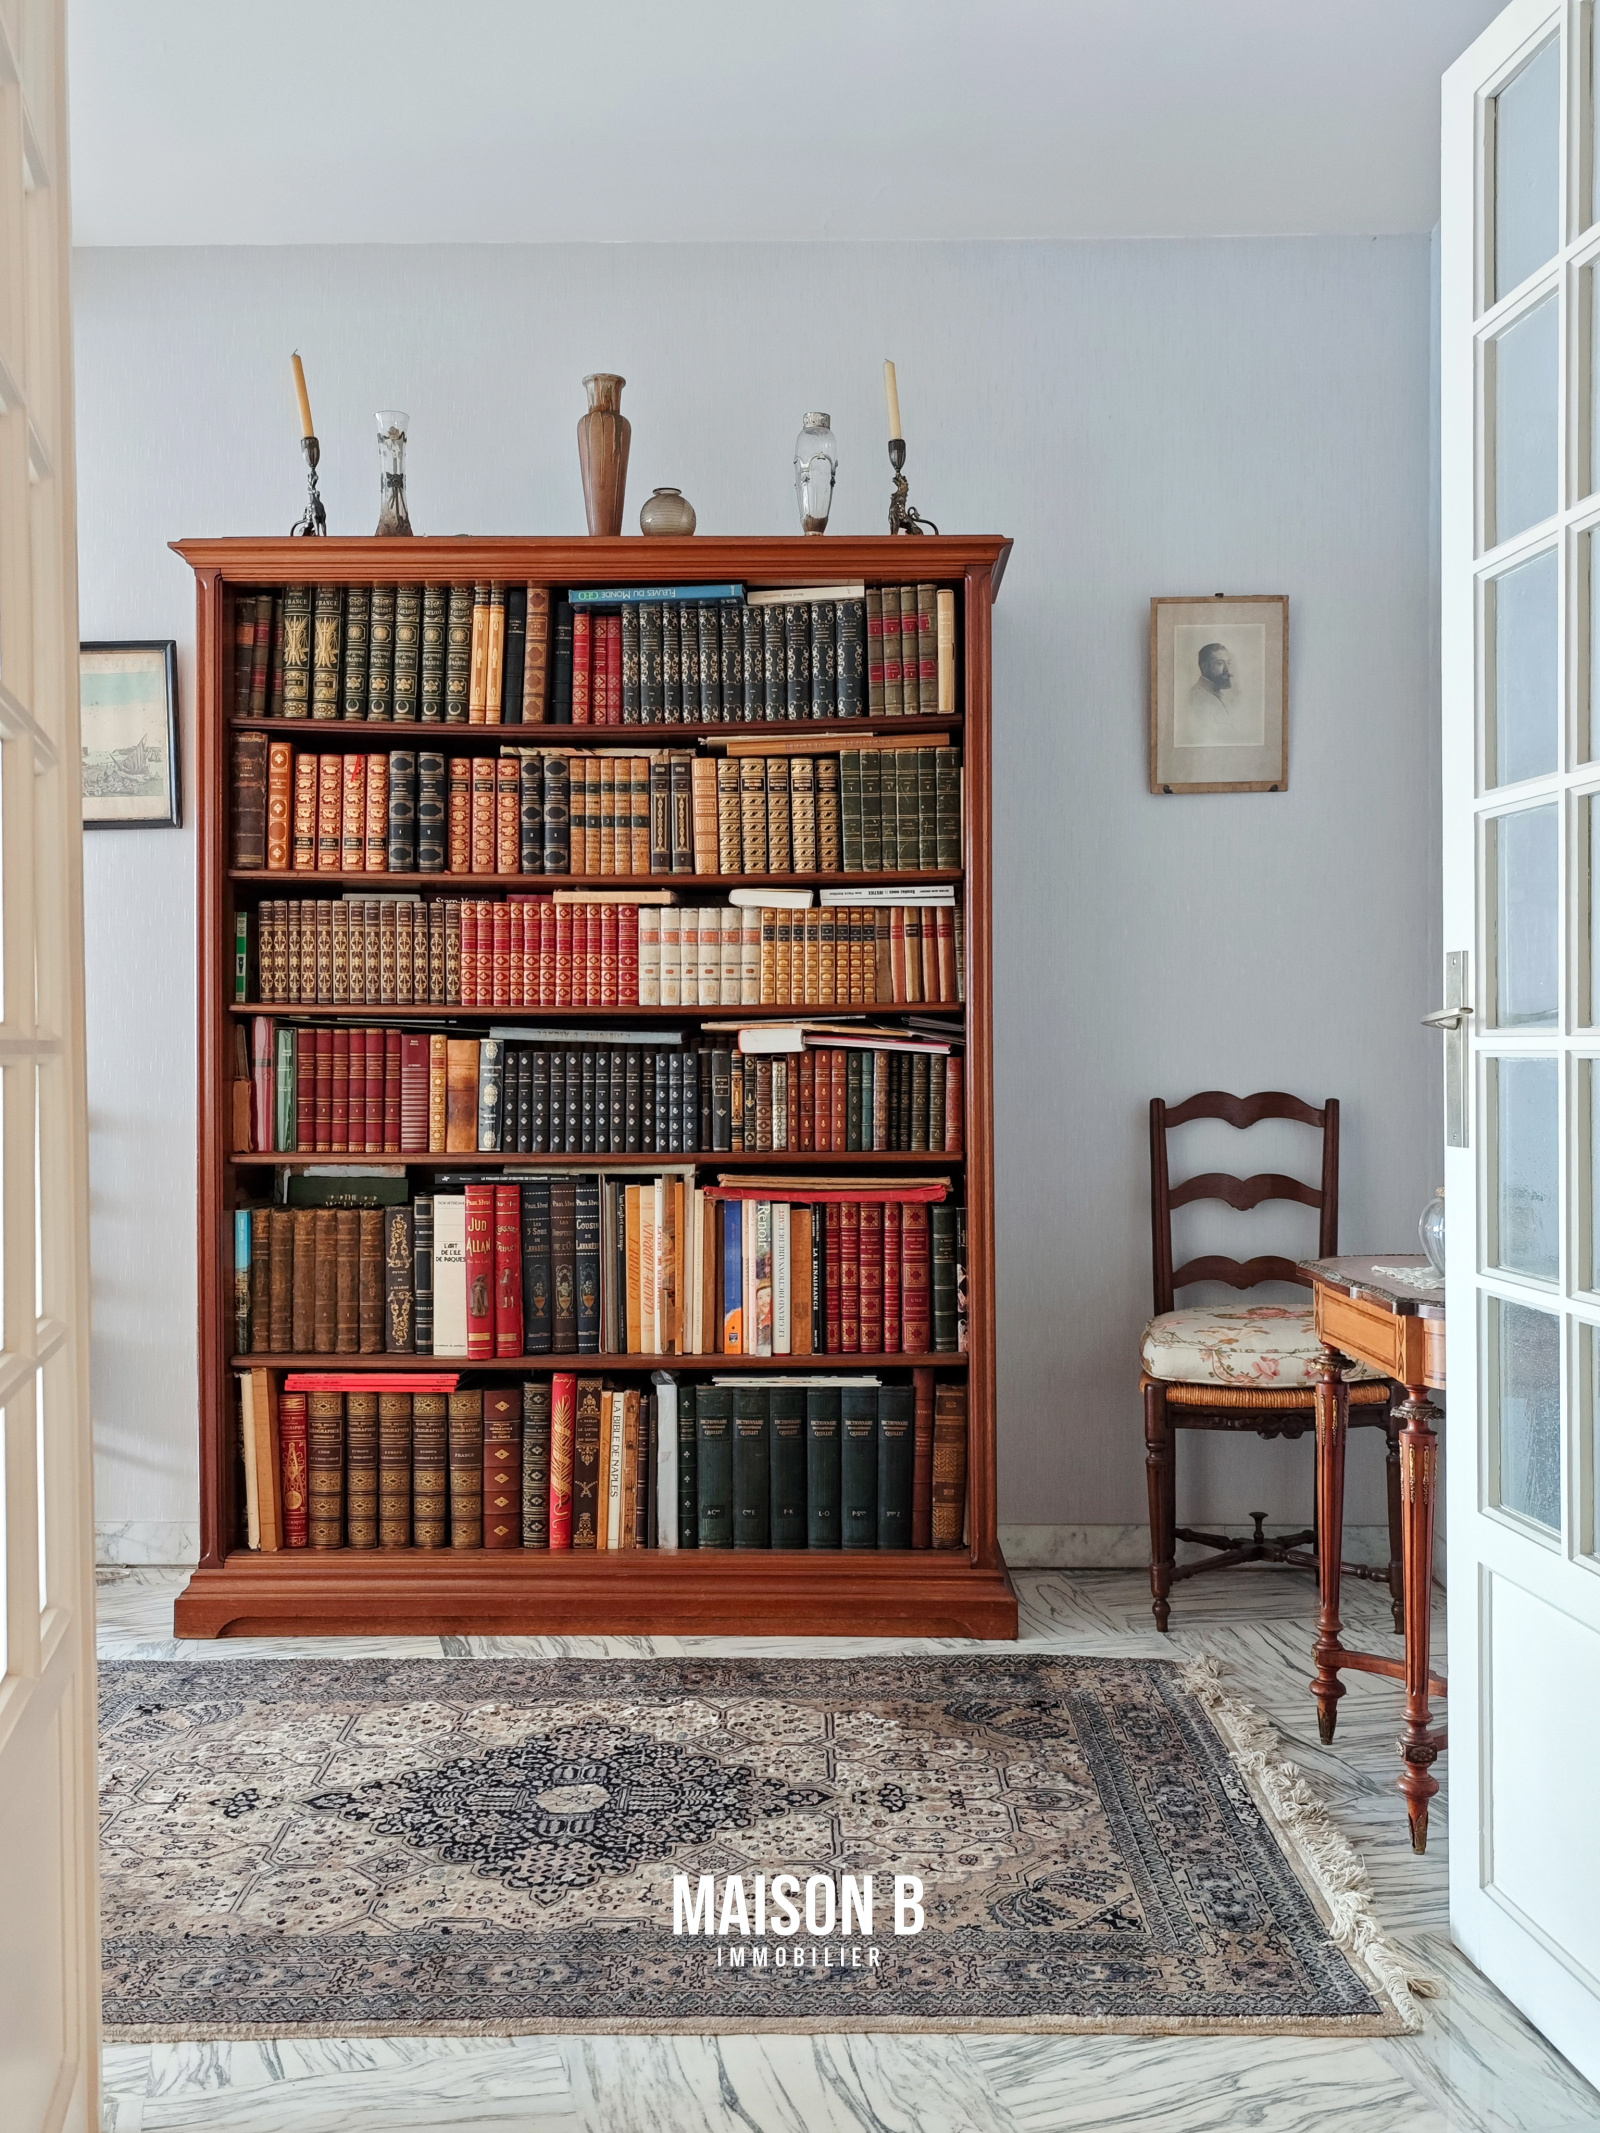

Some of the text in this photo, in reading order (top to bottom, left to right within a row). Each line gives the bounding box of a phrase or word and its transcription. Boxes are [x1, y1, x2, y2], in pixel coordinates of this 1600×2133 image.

[578, 590, 599, 601] GEO
[602, 590, 631, 599] MONDE
[633, 589, 645, 597] DU
[468, 1216, 487, 1232] JUD
[757, 1204, 771, 1248] Renoir
[778, 1232, 785, 1243] DE
[466, 1236, 491, 1257] ALLAN
[813, 1248, 818, 1257] LA
[629, 1235, 640, 1300] COURBET
[643, 1221, 655, 1315] CLAUDE LORRAIN
[778, 1300, 786, 1327] GRAND
[778, 1327, 786, 1338] LE
[610, 1400, 621, 1498] LA BIBLE DE NAPLES
